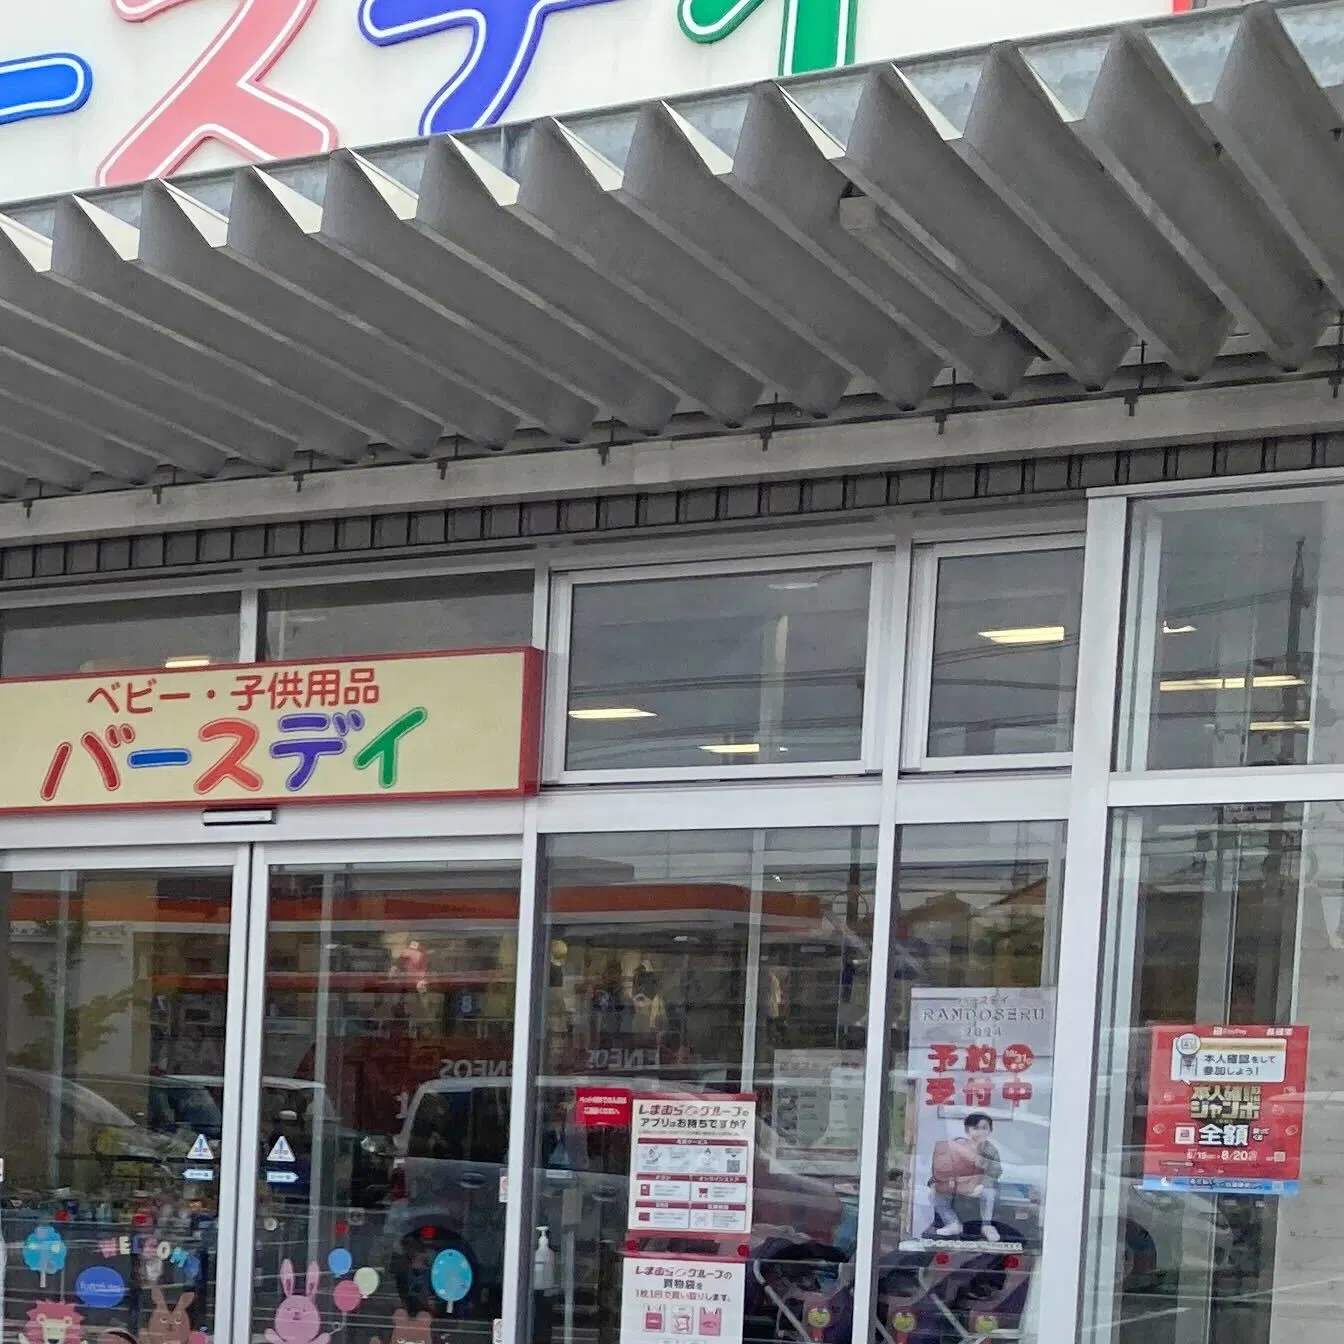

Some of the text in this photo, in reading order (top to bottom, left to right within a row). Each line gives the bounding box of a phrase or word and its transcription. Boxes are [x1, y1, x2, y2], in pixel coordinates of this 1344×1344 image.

[86, 667, 381, 715] ベビー・子供用品
[39, 705, 429, 802] バースデイ
[923, 1007, 1046, 1021] RANDOSERU
[928, 1044, 998, 1074] 予約
[1203, 1054, 1277, 1065] 本人確認をして
[925, 1077, 1034, 1108] 受付中
[1198, 1123, 1250, 1146] 全額
